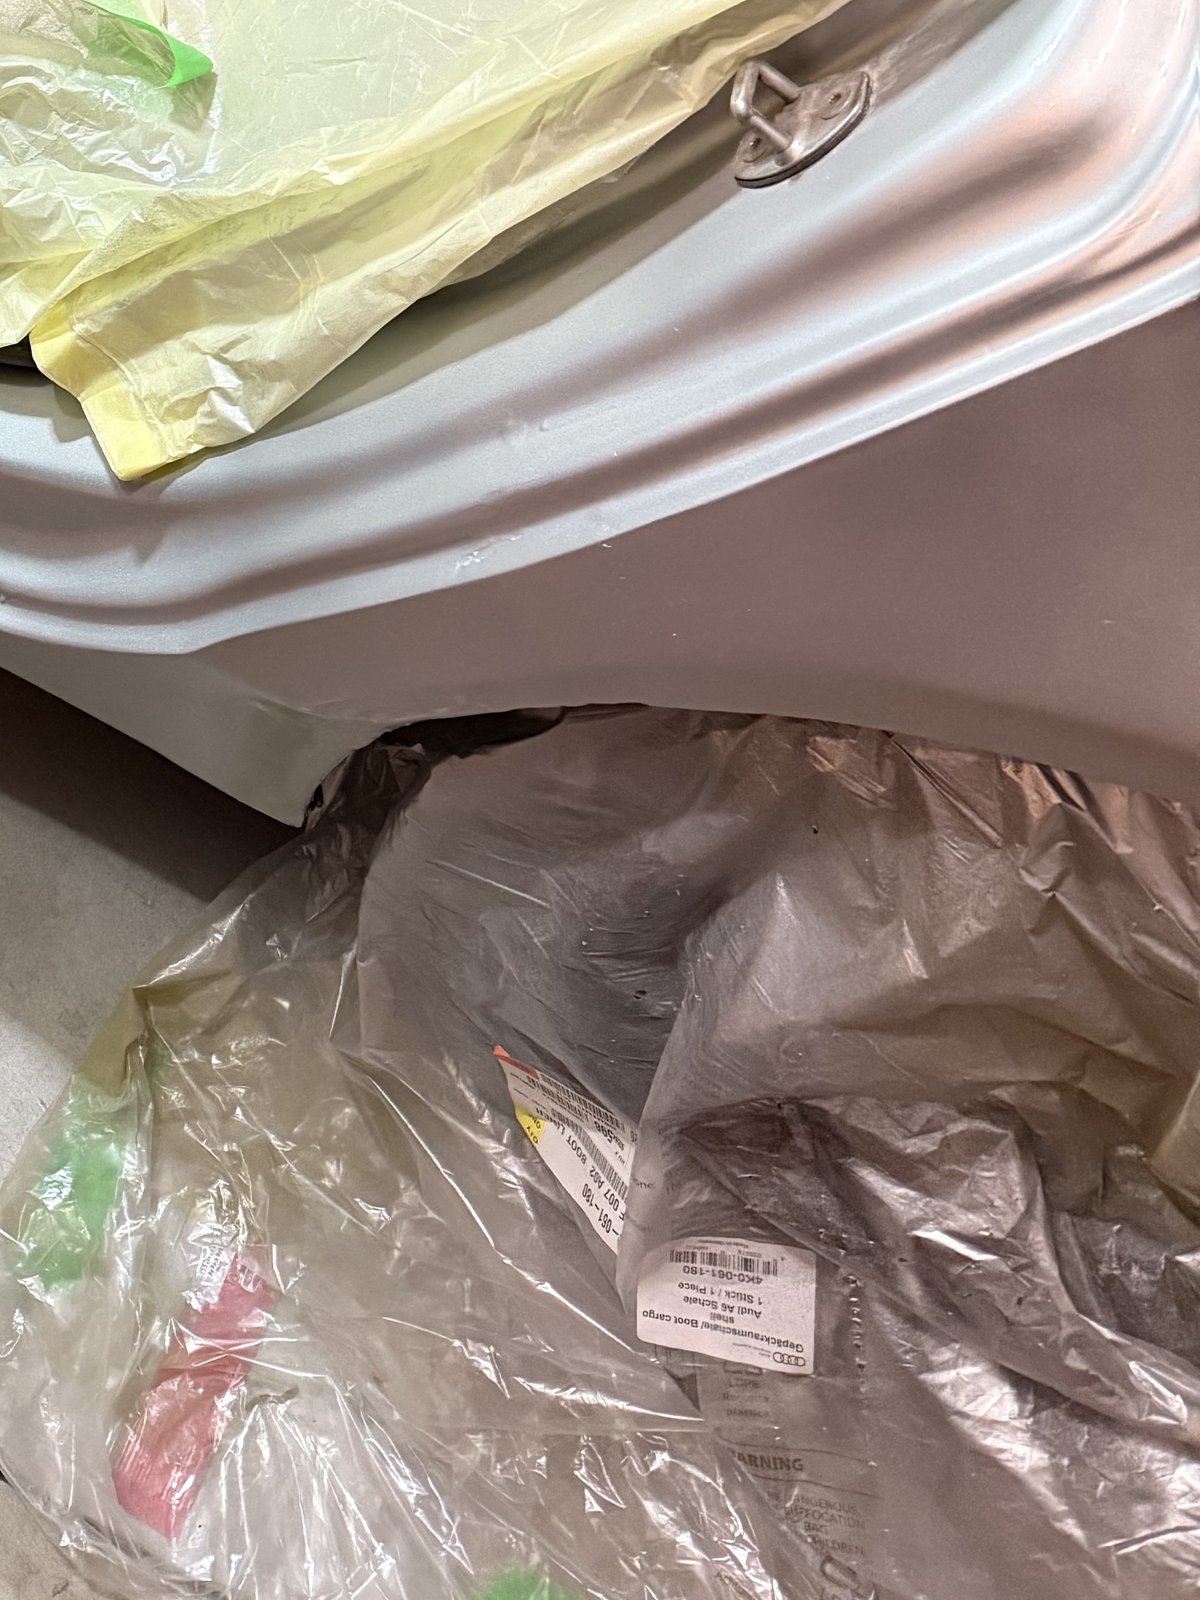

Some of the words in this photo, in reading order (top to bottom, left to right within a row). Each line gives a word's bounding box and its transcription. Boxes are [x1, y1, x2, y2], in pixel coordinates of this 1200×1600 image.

[566, 1135, 588, 1165] BOOT
[678, 1282, 707, 1294] Piece
[724, 1290, 754, 1305] Stück
[721, 1303, 735, 1314] A6
[737, 1305, 762, 1319] Audi
[642, 1309, 672, 1322] cargo
[674, 1315, 699, 1328] Boot
